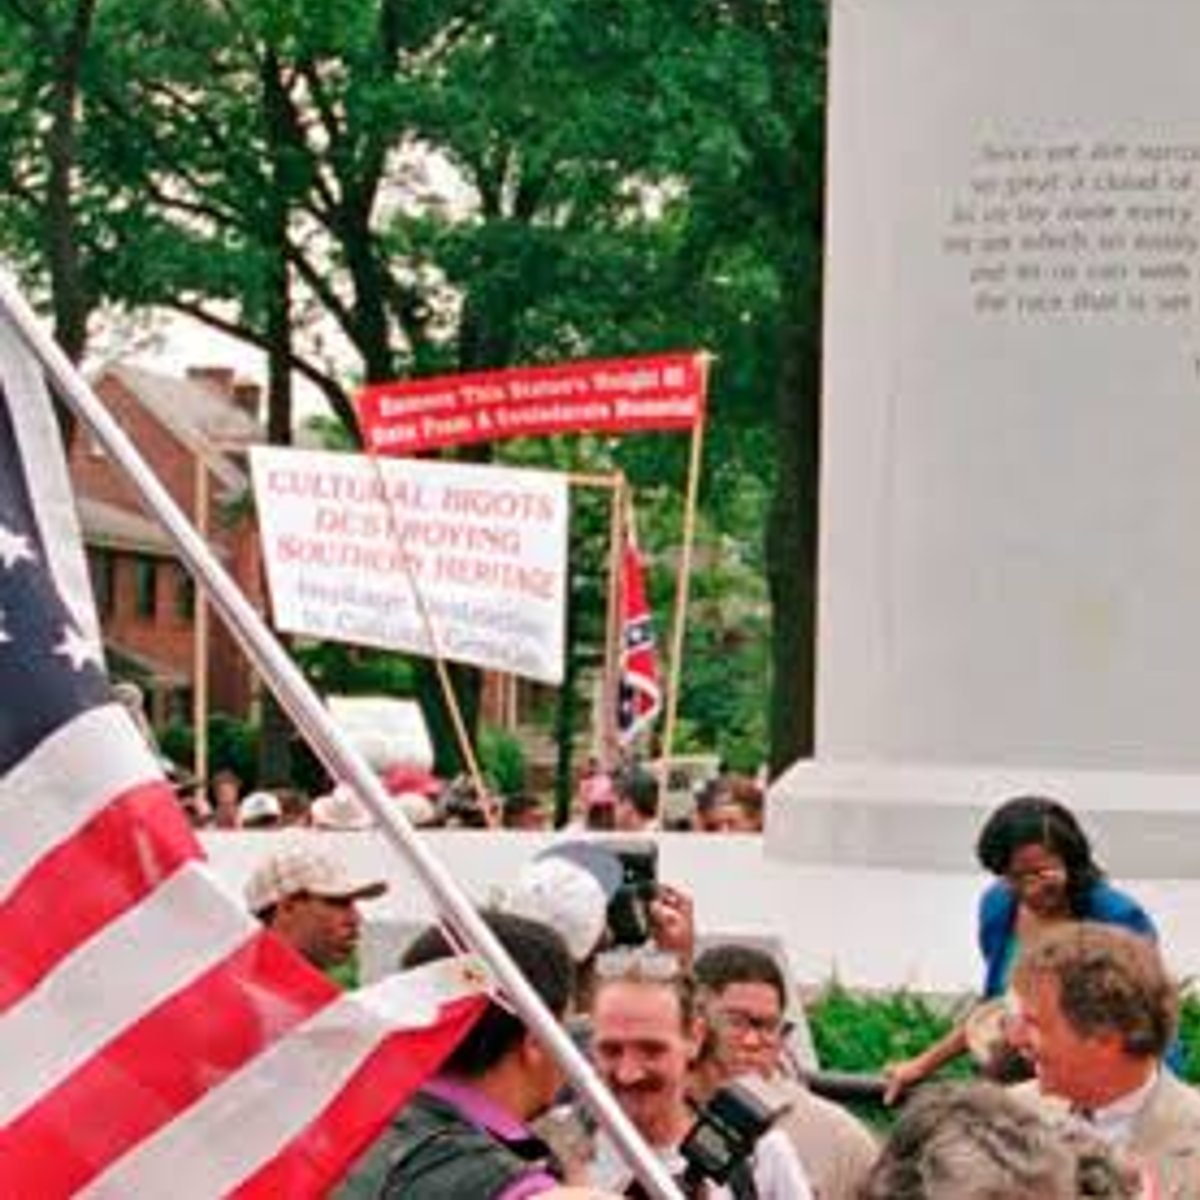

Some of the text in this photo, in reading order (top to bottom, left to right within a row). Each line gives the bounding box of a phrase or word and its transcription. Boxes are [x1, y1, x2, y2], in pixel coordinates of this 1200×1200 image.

[267, 470, 555, 521] CULTURAL BIGOTS
[315, 506, 521, 555] DESTROYING
